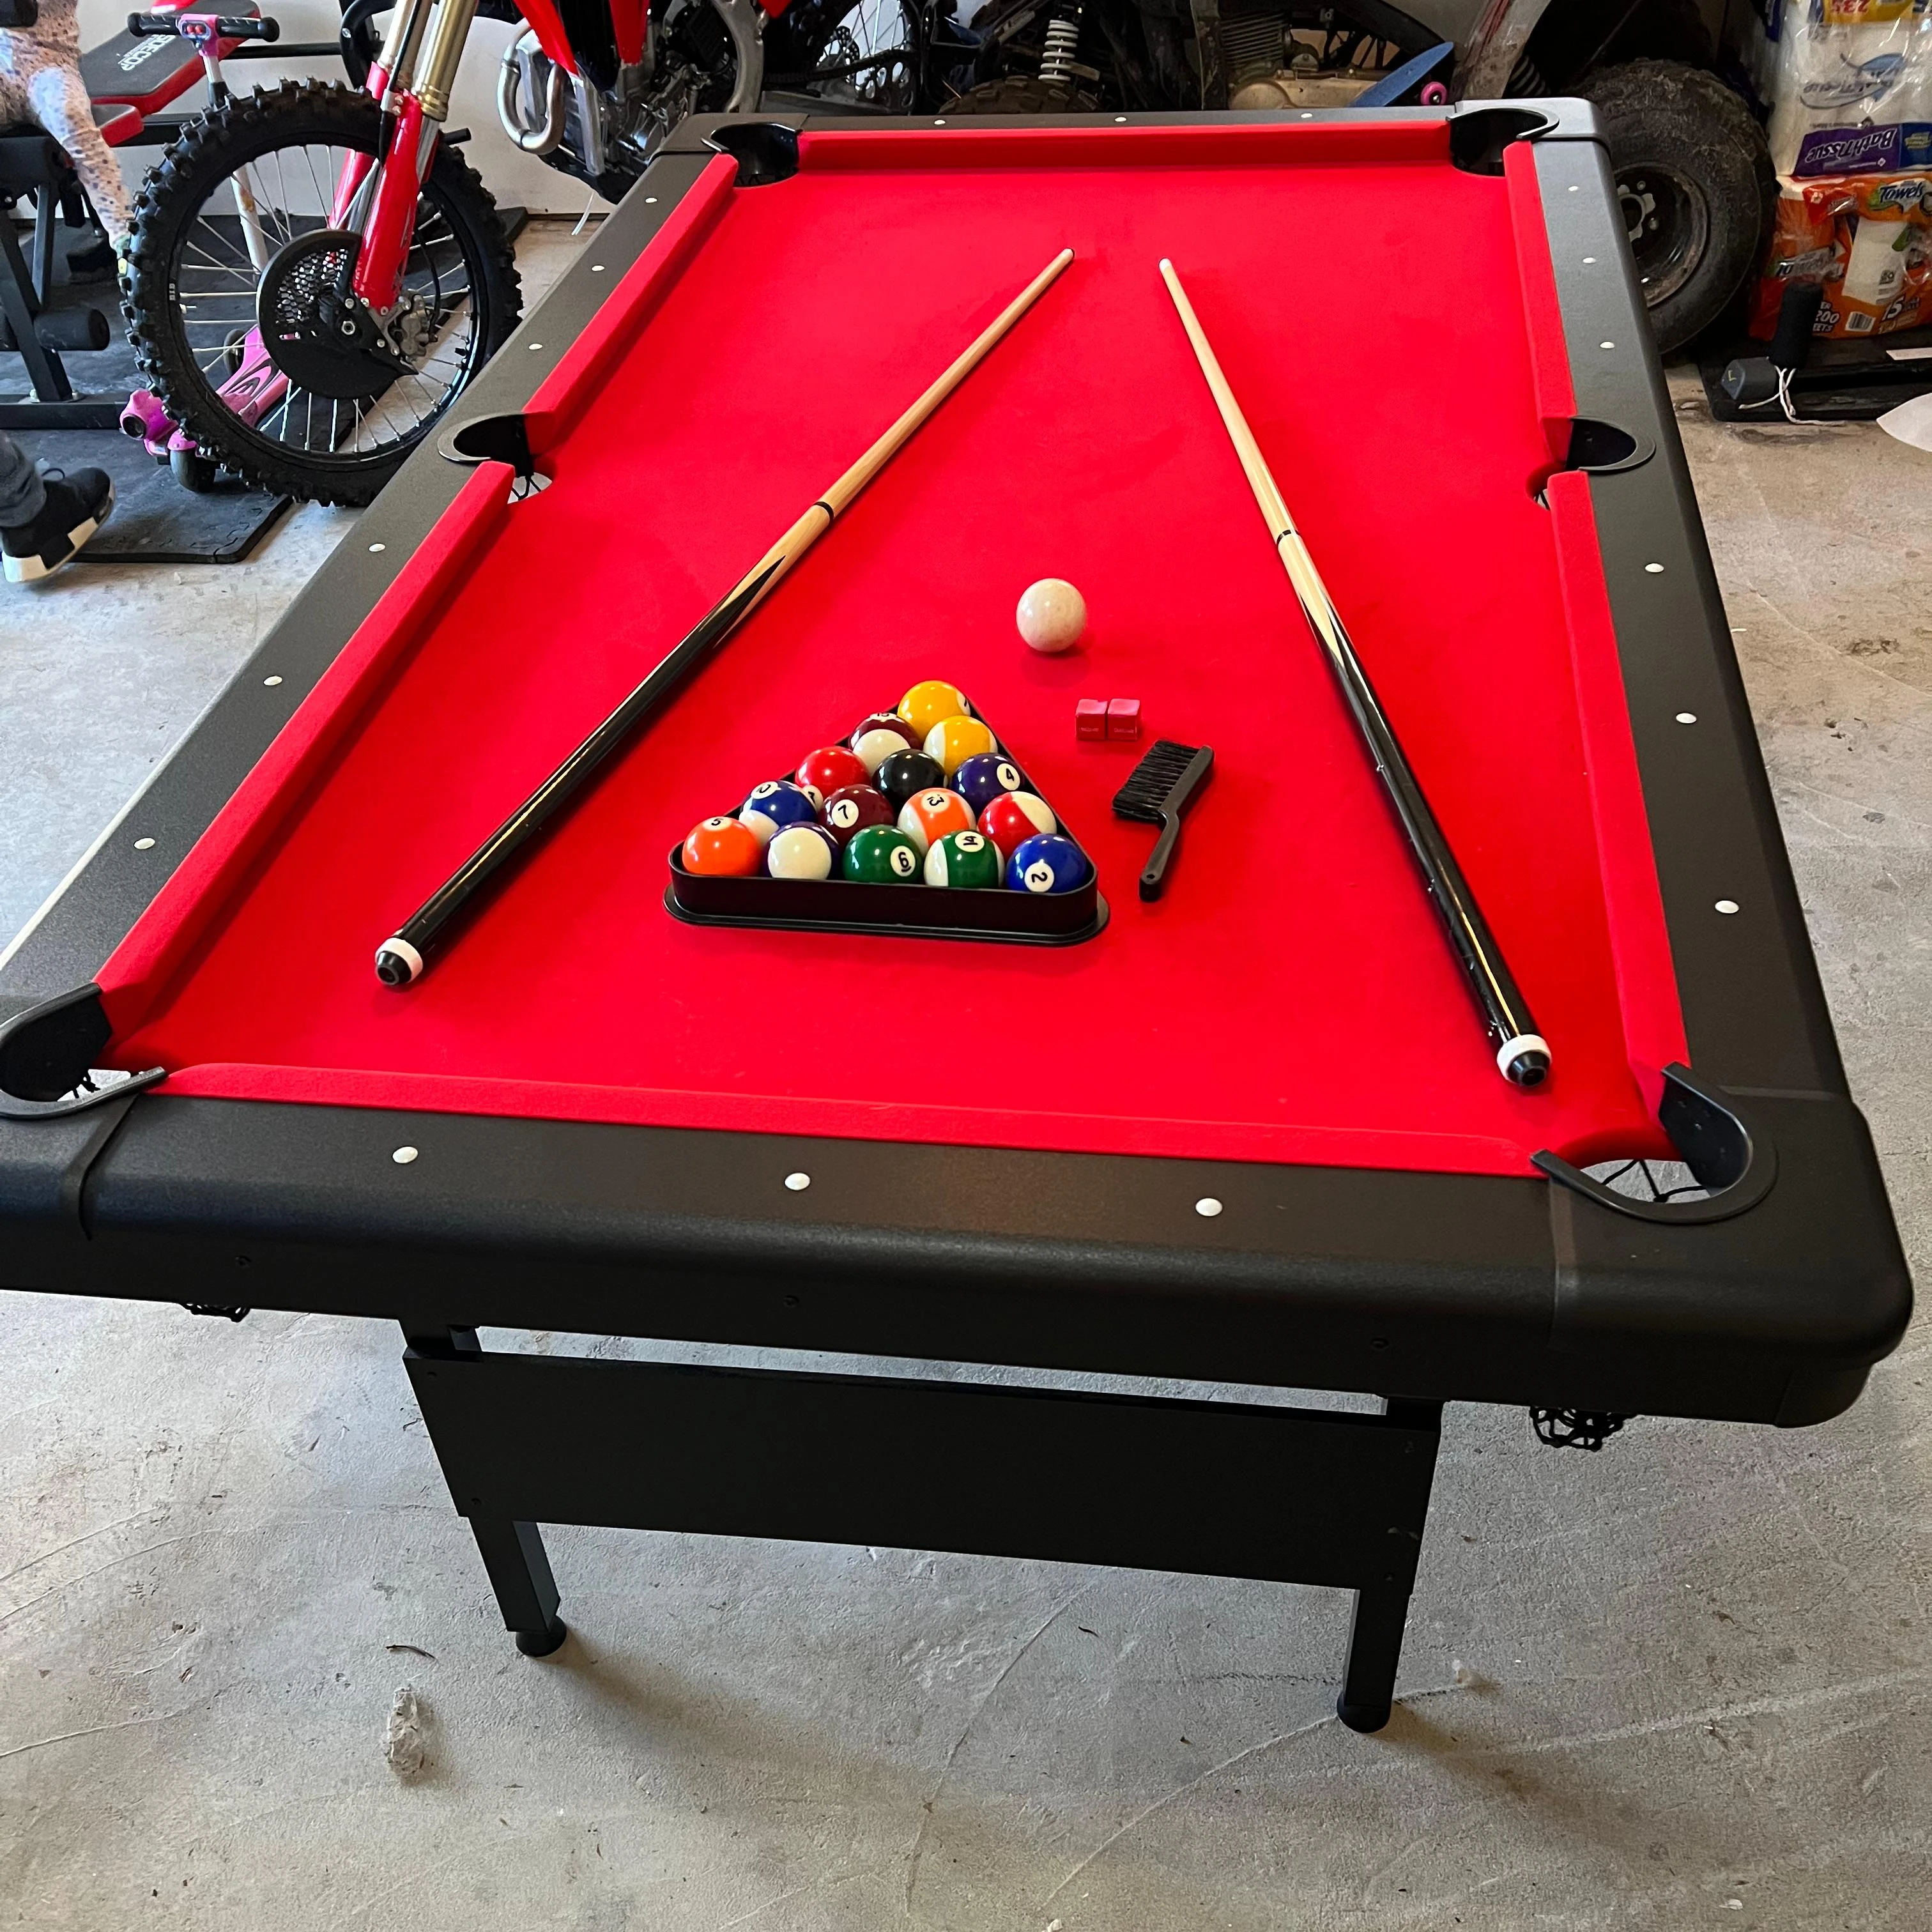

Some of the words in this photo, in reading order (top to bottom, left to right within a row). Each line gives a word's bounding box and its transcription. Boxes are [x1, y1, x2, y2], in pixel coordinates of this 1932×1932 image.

[1853, 128, 1897, 155] Bath
[1805, 141, 1855, 162] Tissue
[1880, 181, 1922, 203] Towels
[1005, 767, 1015, 782] 4
[926, 795, 945, 807] 13
[838, 804, 849, 820] 7
[710, 818, 723, 827] 5
[962, 835, 979, 847] 14
[898, 851, 910, 871] 6
[1031, 871, 1048, 883] 2
